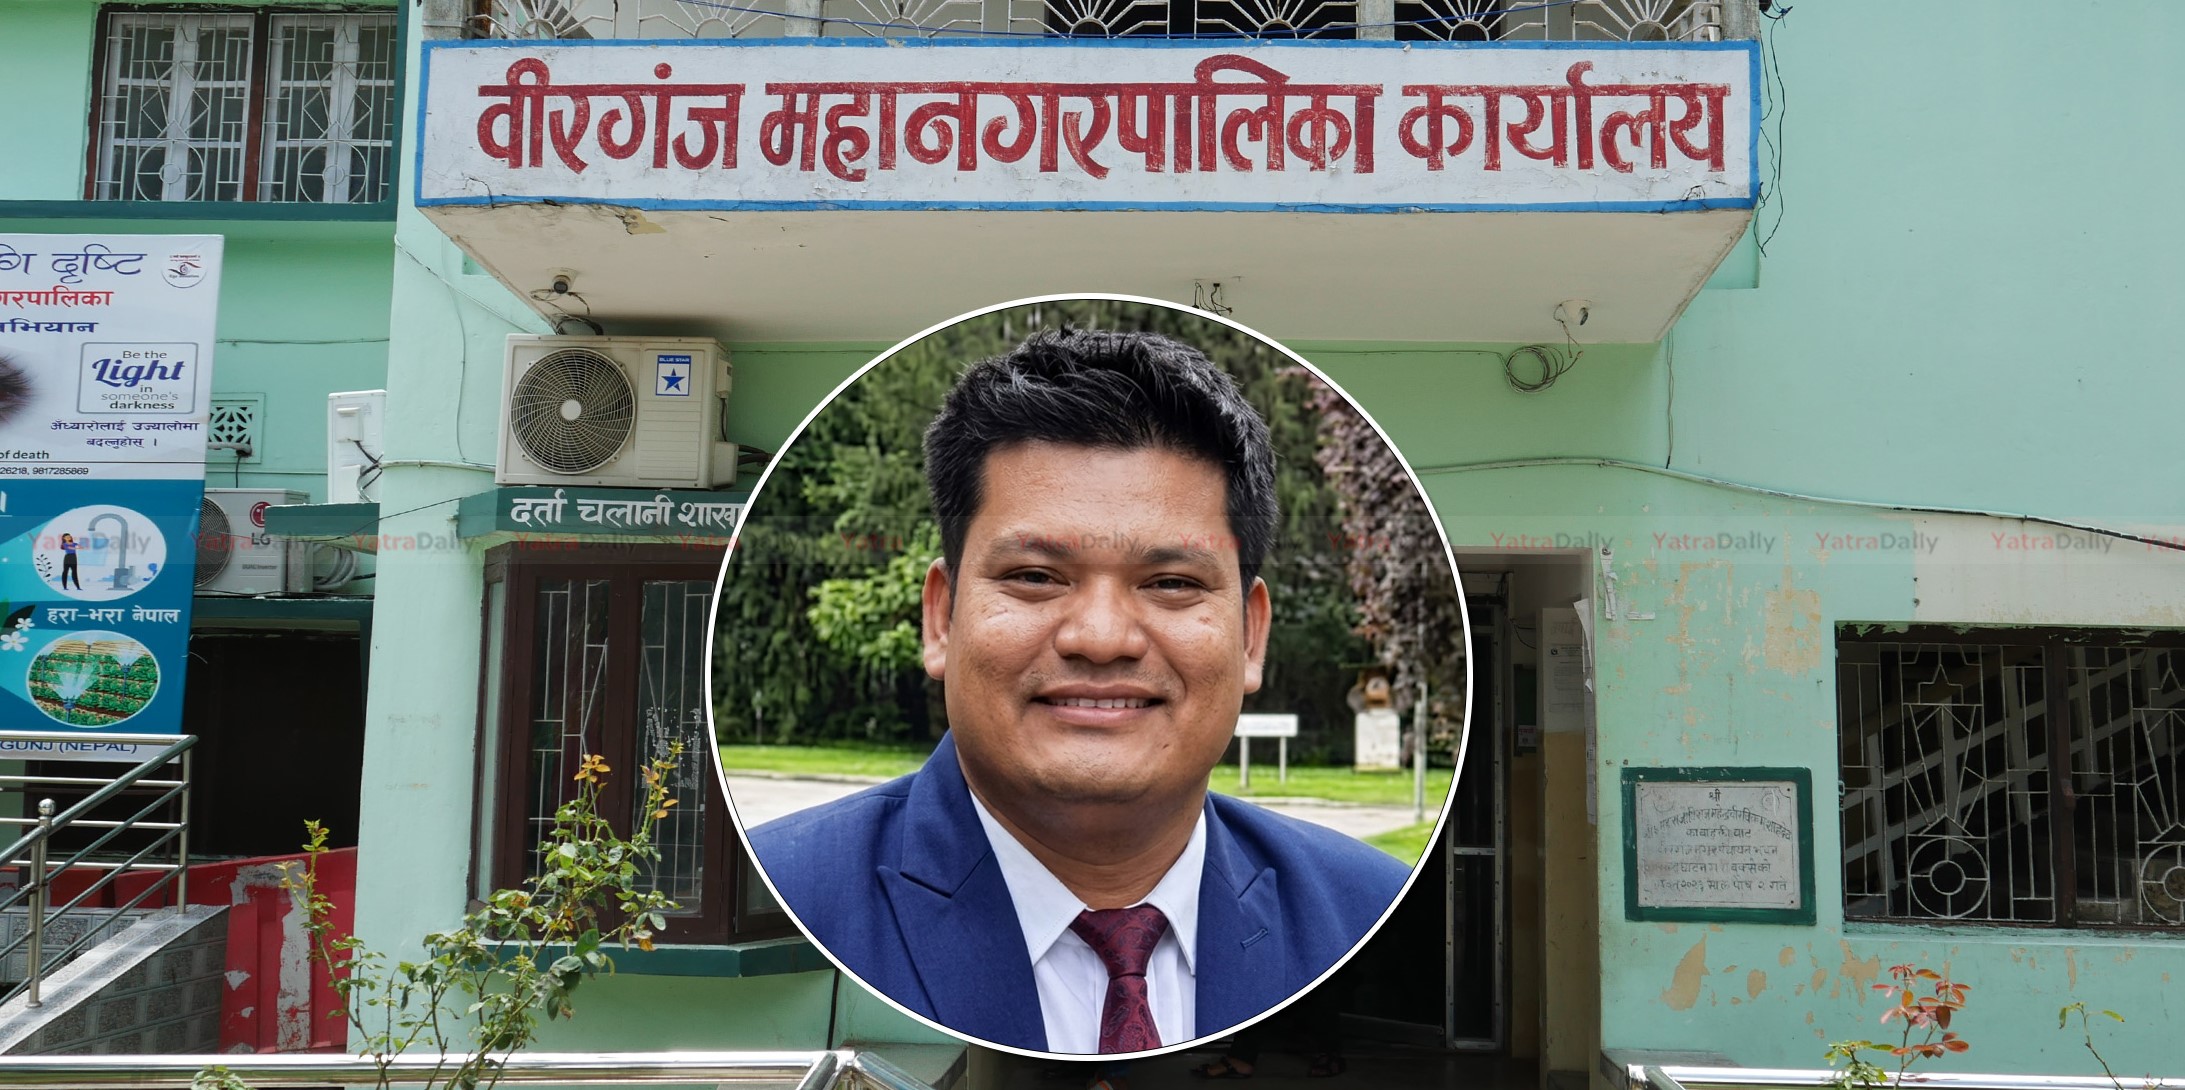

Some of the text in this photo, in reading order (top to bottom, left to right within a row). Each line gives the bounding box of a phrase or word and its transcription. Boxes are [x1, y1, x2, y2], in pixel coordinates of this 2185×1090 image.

[478, 54, 1731, 182] वीरगंज महानगरपालिका कार्यालय
[52, 244, 148, 284] दृष्टि
[122, 350, 167, 359] Be the
[92, 358, 185, 388] Light
[140, 385, 153, 393] in
[101, 392, 179, 400] someone's
[109, 401, 175, 409] darkness
[131, 420, 200, 432] उज्यालोमा
[12, 450, 50, 459] death
[510, 488, 569, 528] दर्ता
[576, 494, 675, 528] चलानी
[251, 532, 271, 546] LG
[47, 604, 181, 625] हरा-भरा नेपाल
[59, 741, 138, 754] (NEPAL)
